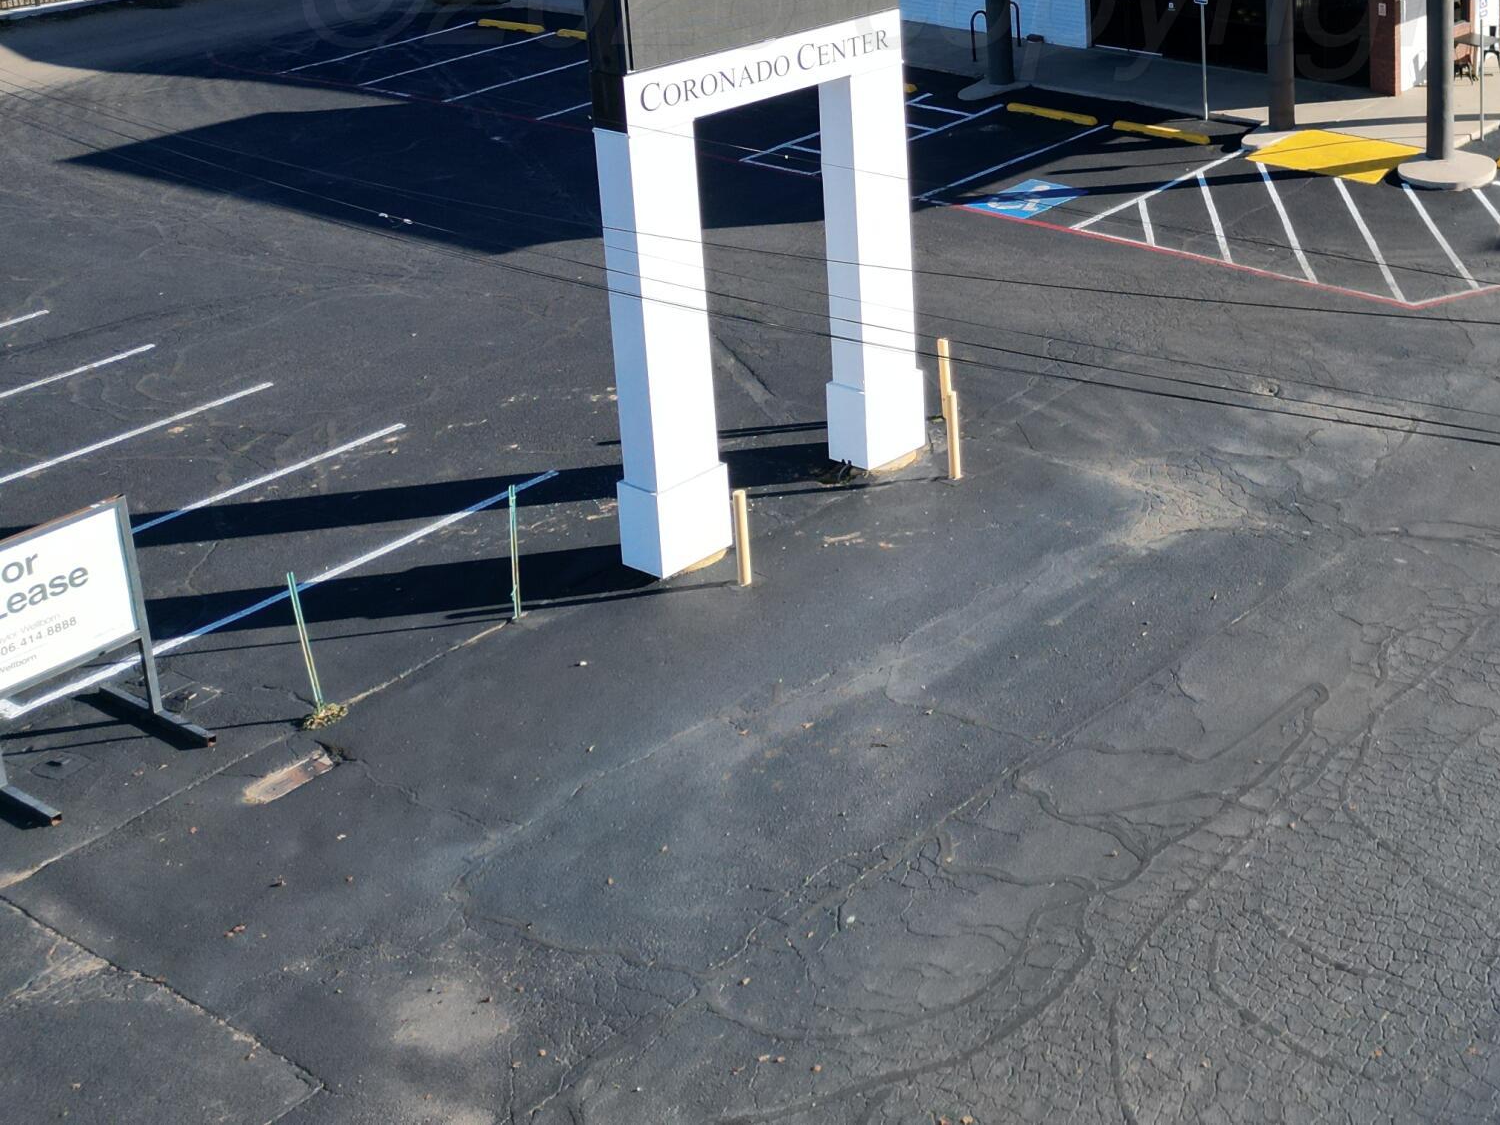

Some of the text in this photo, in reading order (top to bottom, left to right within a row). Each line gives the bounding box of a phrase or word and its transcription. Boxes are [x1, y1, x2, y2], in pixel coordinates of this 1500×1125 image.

[1, 553, 39, 584] or
[0, 566, 89, 619] ease
[0, 616, 77, 656] 06.414.8888
